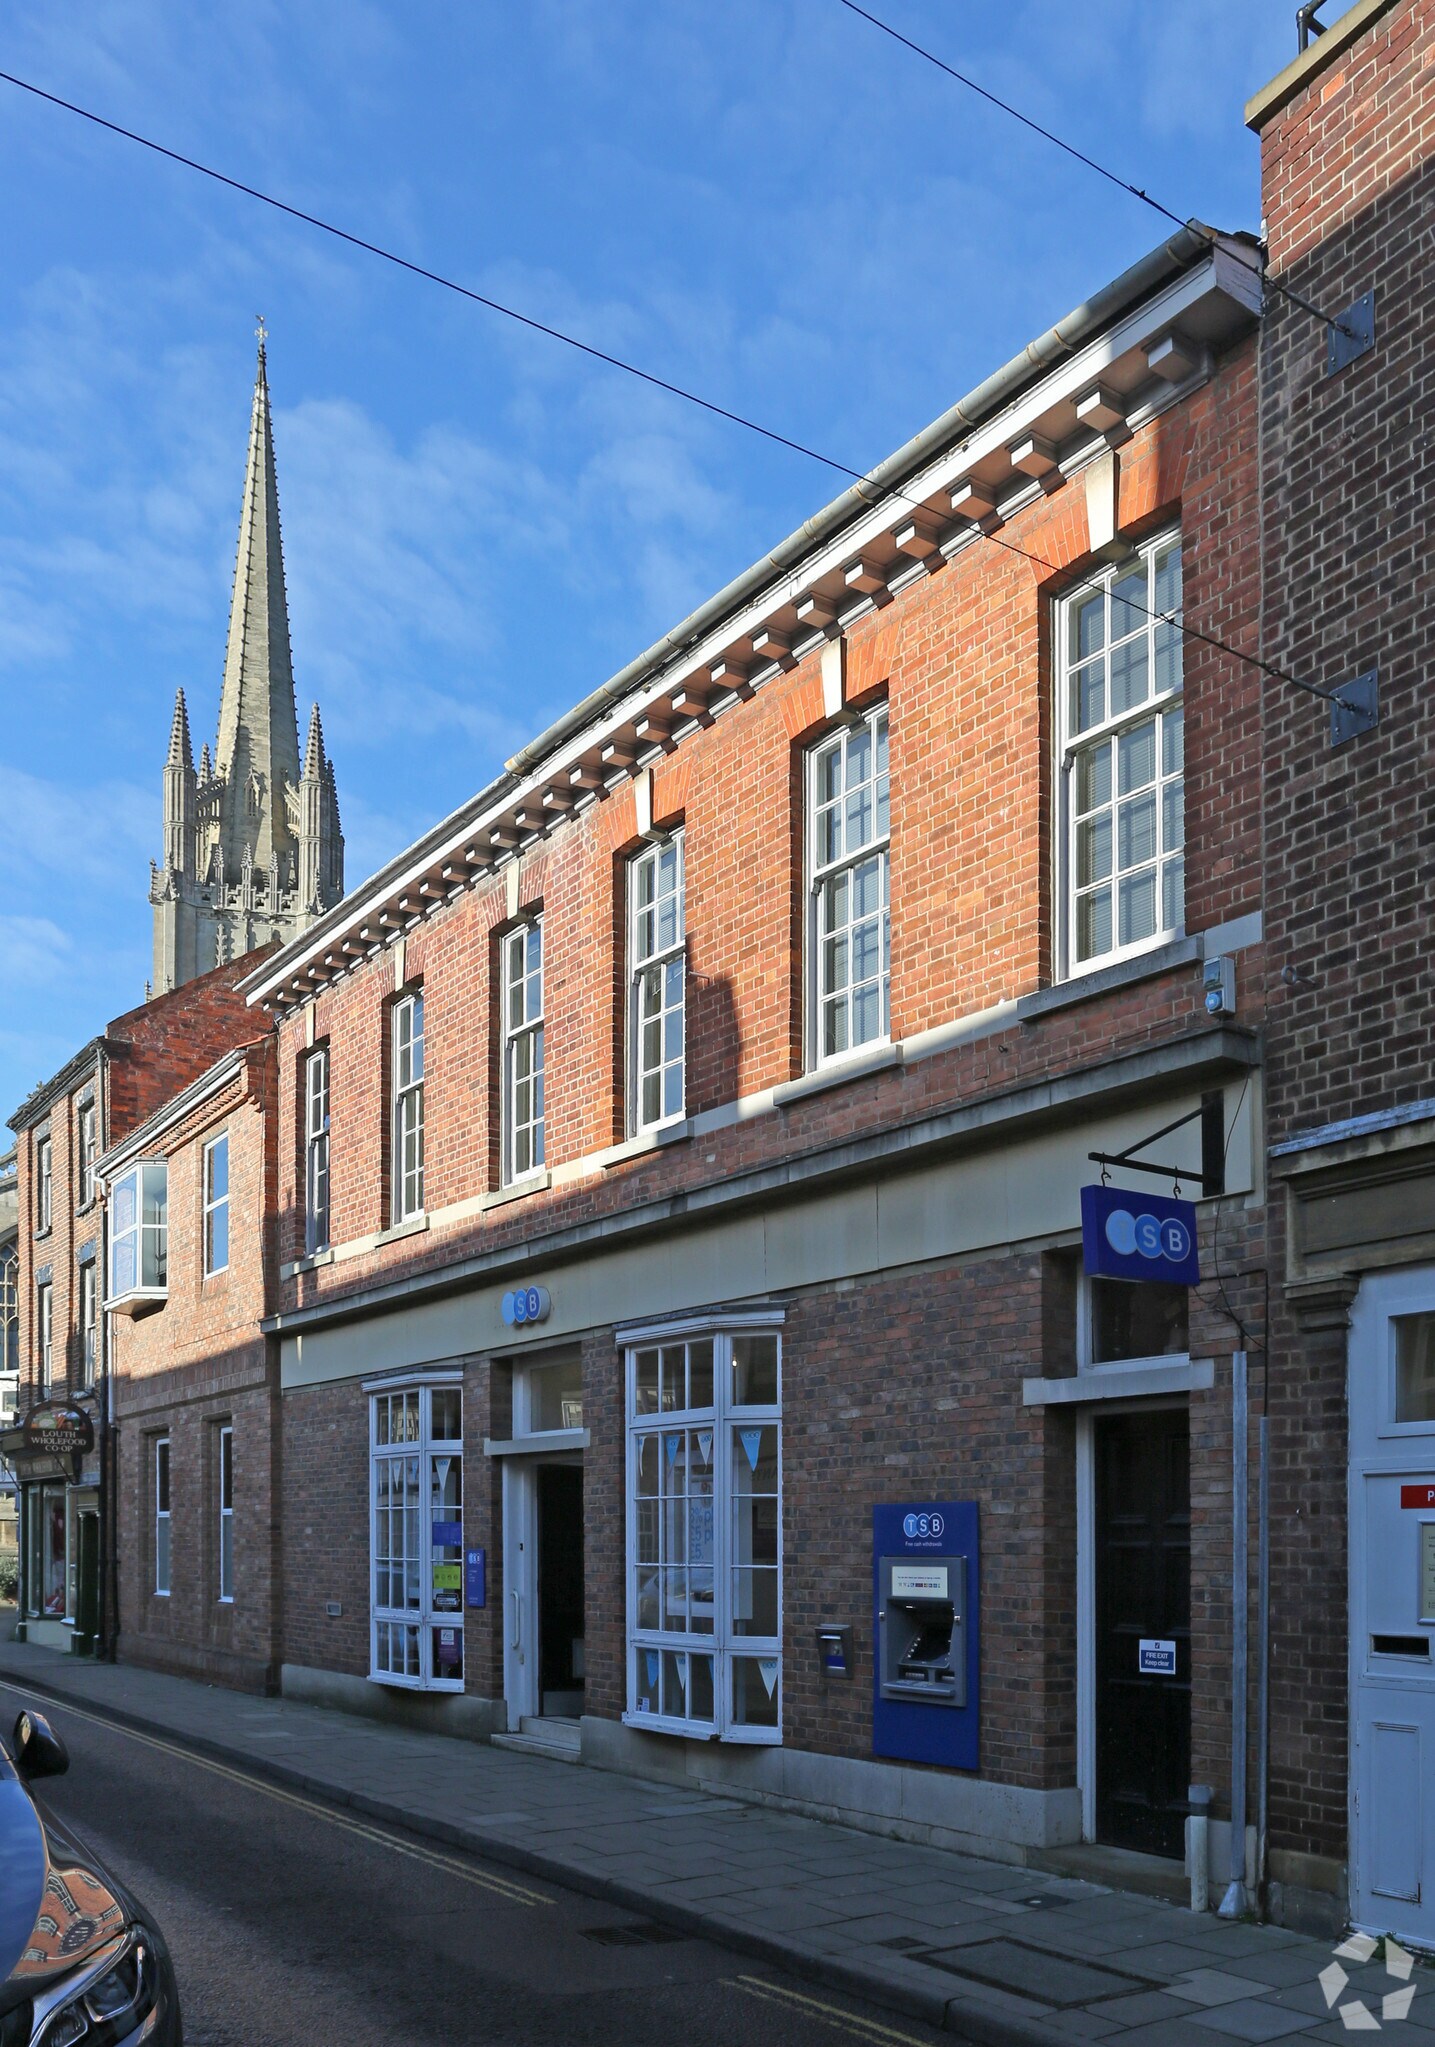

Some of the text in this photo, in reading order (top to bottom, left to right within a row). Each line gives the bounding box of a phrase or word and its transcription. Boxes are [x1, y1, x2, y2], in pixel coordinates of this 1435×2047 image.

[42, 1430, 76, 1438] LOUTH
[31, 1437, 87, 1446] WHOLEFOOD
[1427, 1490, 1435, 1502] P
[704, 1505, 713, 1527] pl
[704, 1526, 713, 1545] pl
[1145, 1659, 1158, 1667] Keep
